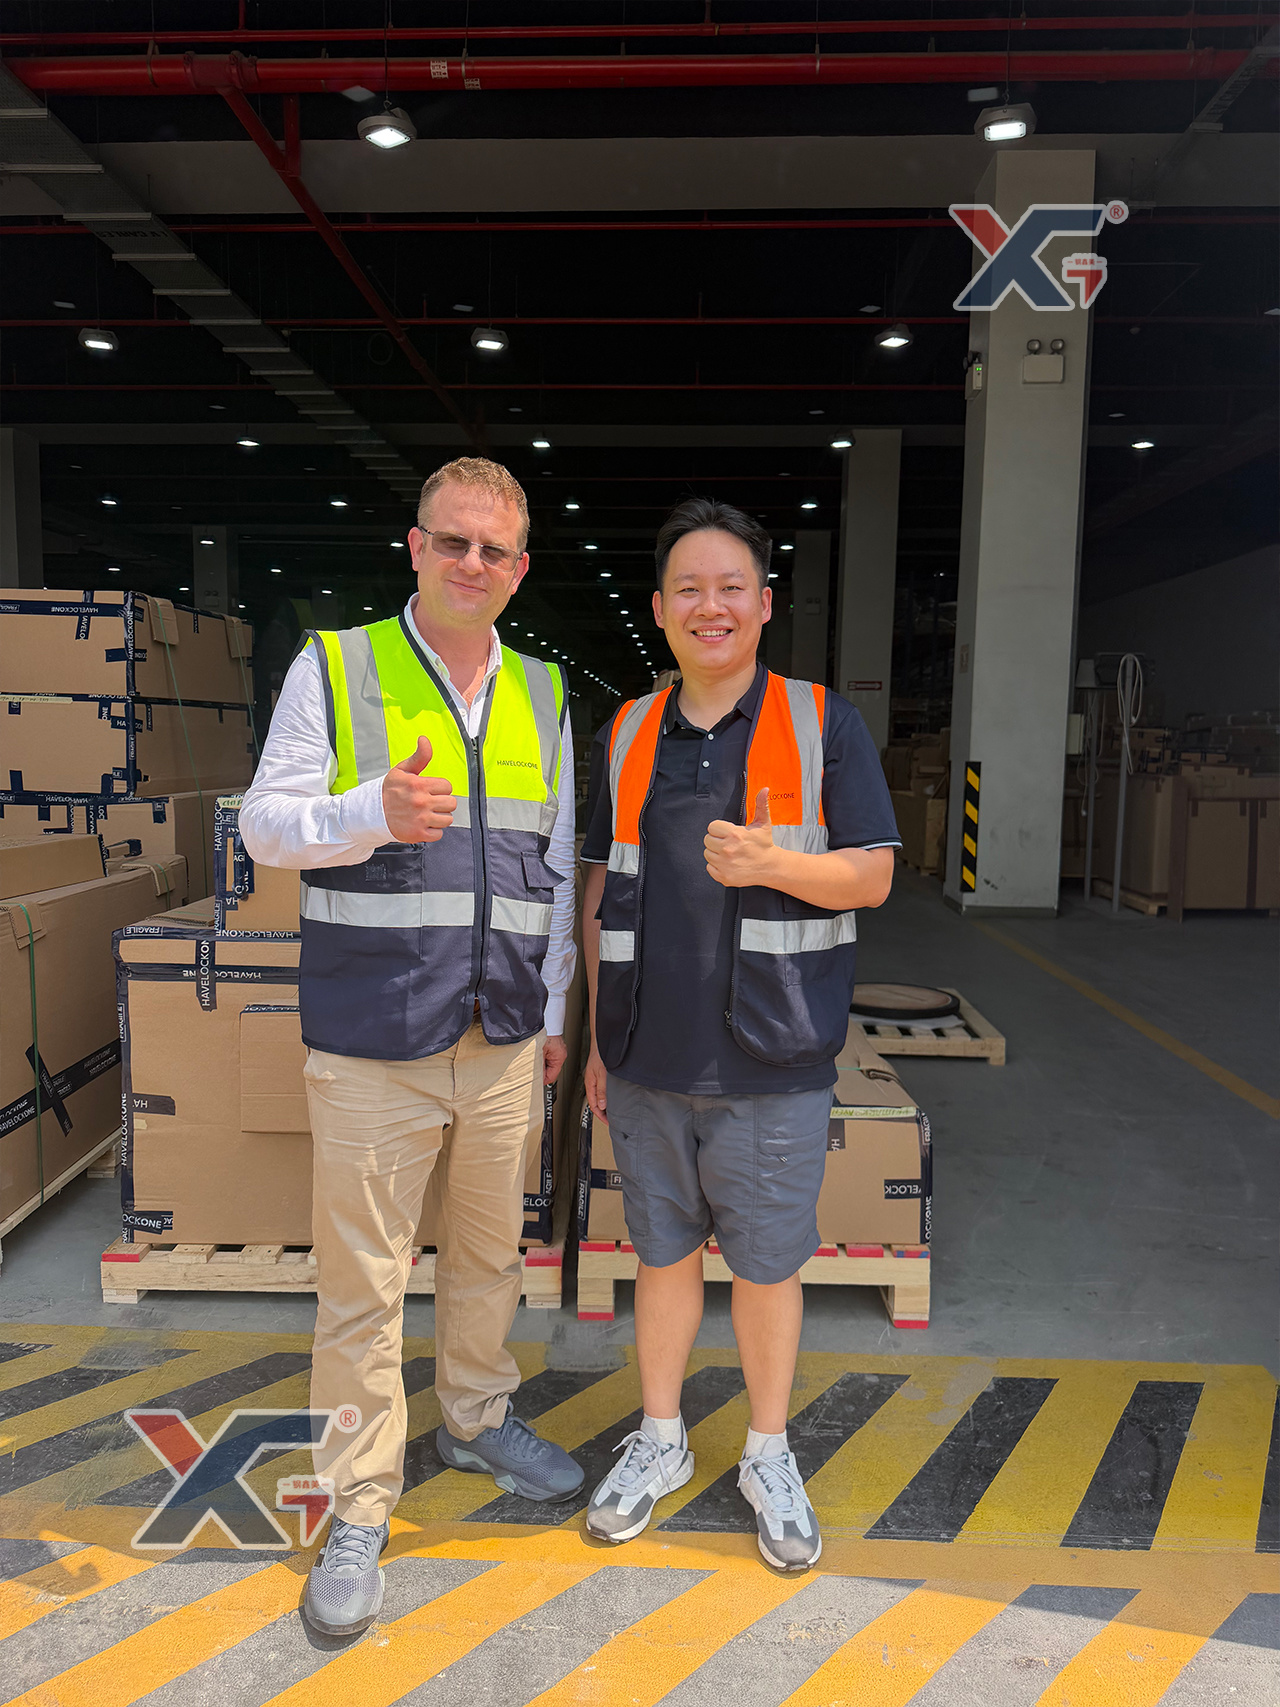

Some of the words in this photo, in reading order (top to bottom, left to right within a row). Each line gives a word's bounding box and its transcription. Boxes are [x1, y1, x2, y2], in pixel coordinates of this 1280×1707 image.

[496, 760, 538, 770] HAVELOCKONE
[126, 926, 160, 934] FRAGILE
[122, 1213, 162, 1229] OCKONE
